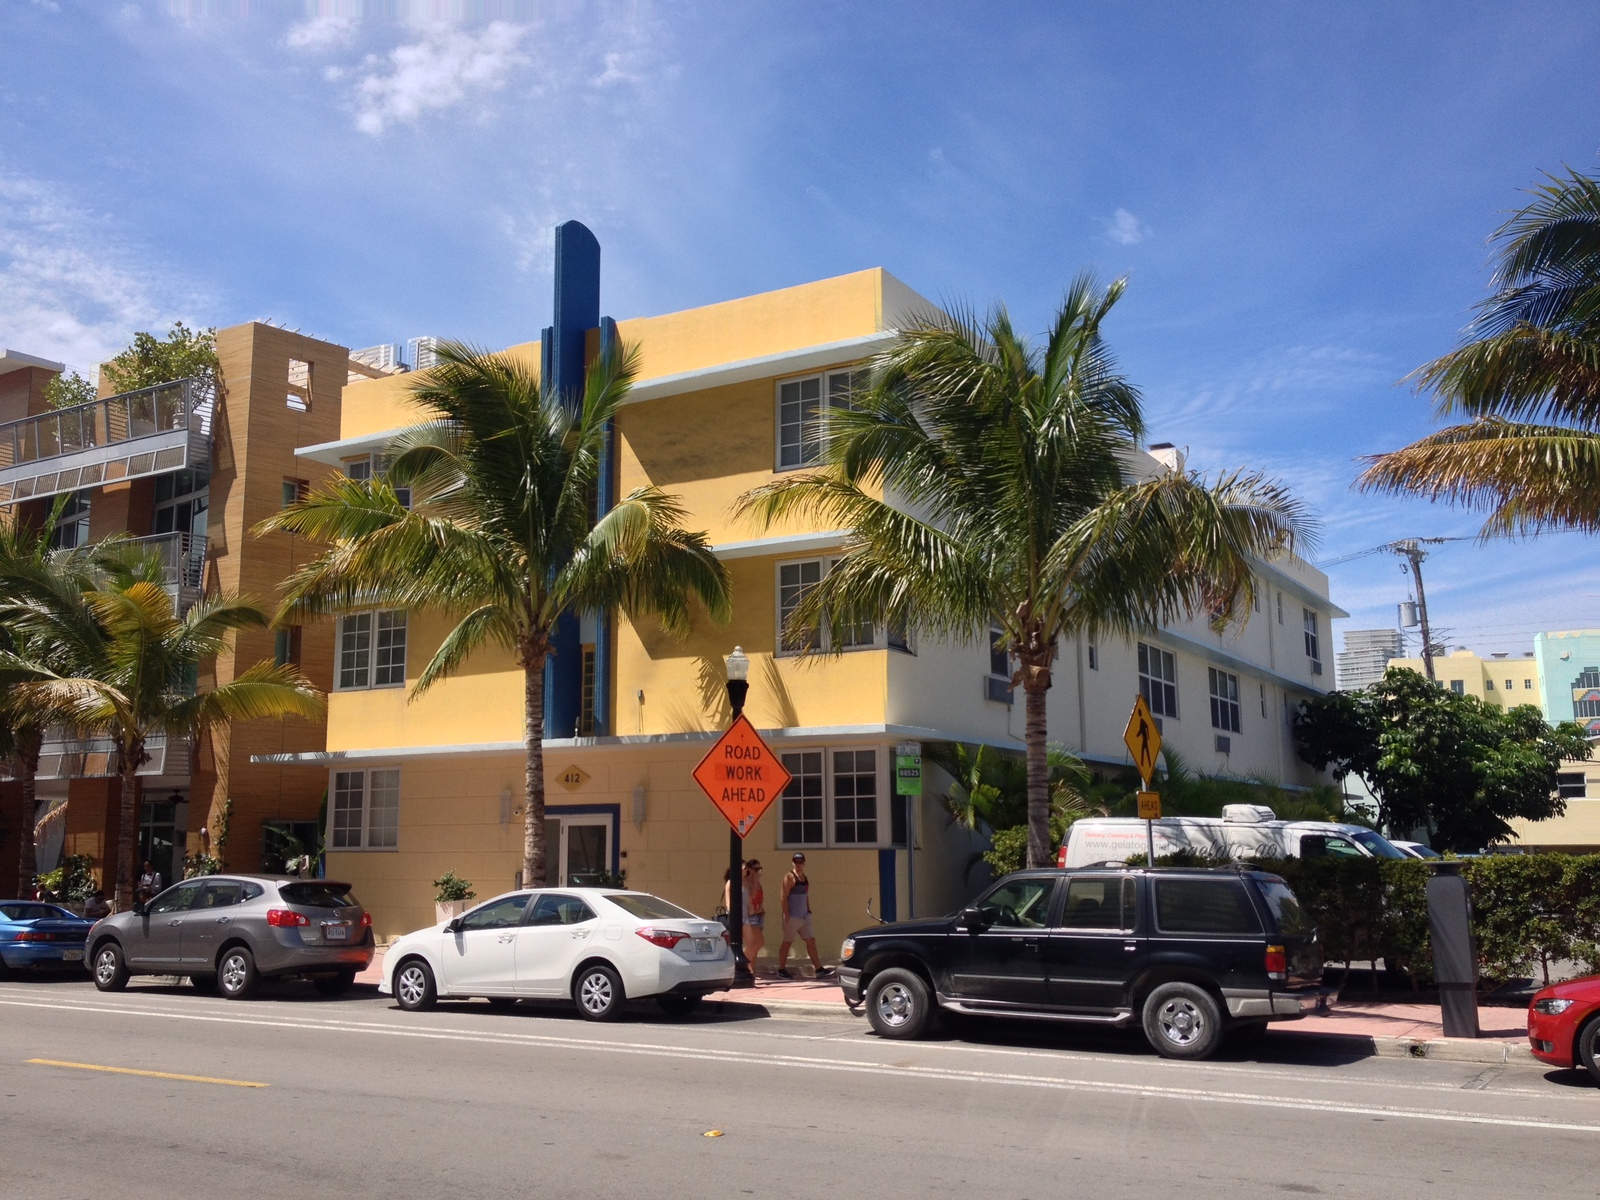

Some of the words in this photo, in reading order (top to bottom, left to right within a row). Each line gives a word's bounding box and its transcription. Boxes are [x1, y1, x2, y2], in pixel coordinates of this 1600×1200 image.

[725, 745, 761, 760] ROAD
[564, 773, 580, 783] 412
[725, 765, 762, 780] WORK
[722, 787, 766, 802] AHEAD
[1140, 800, 1159, 811] AHEAD
